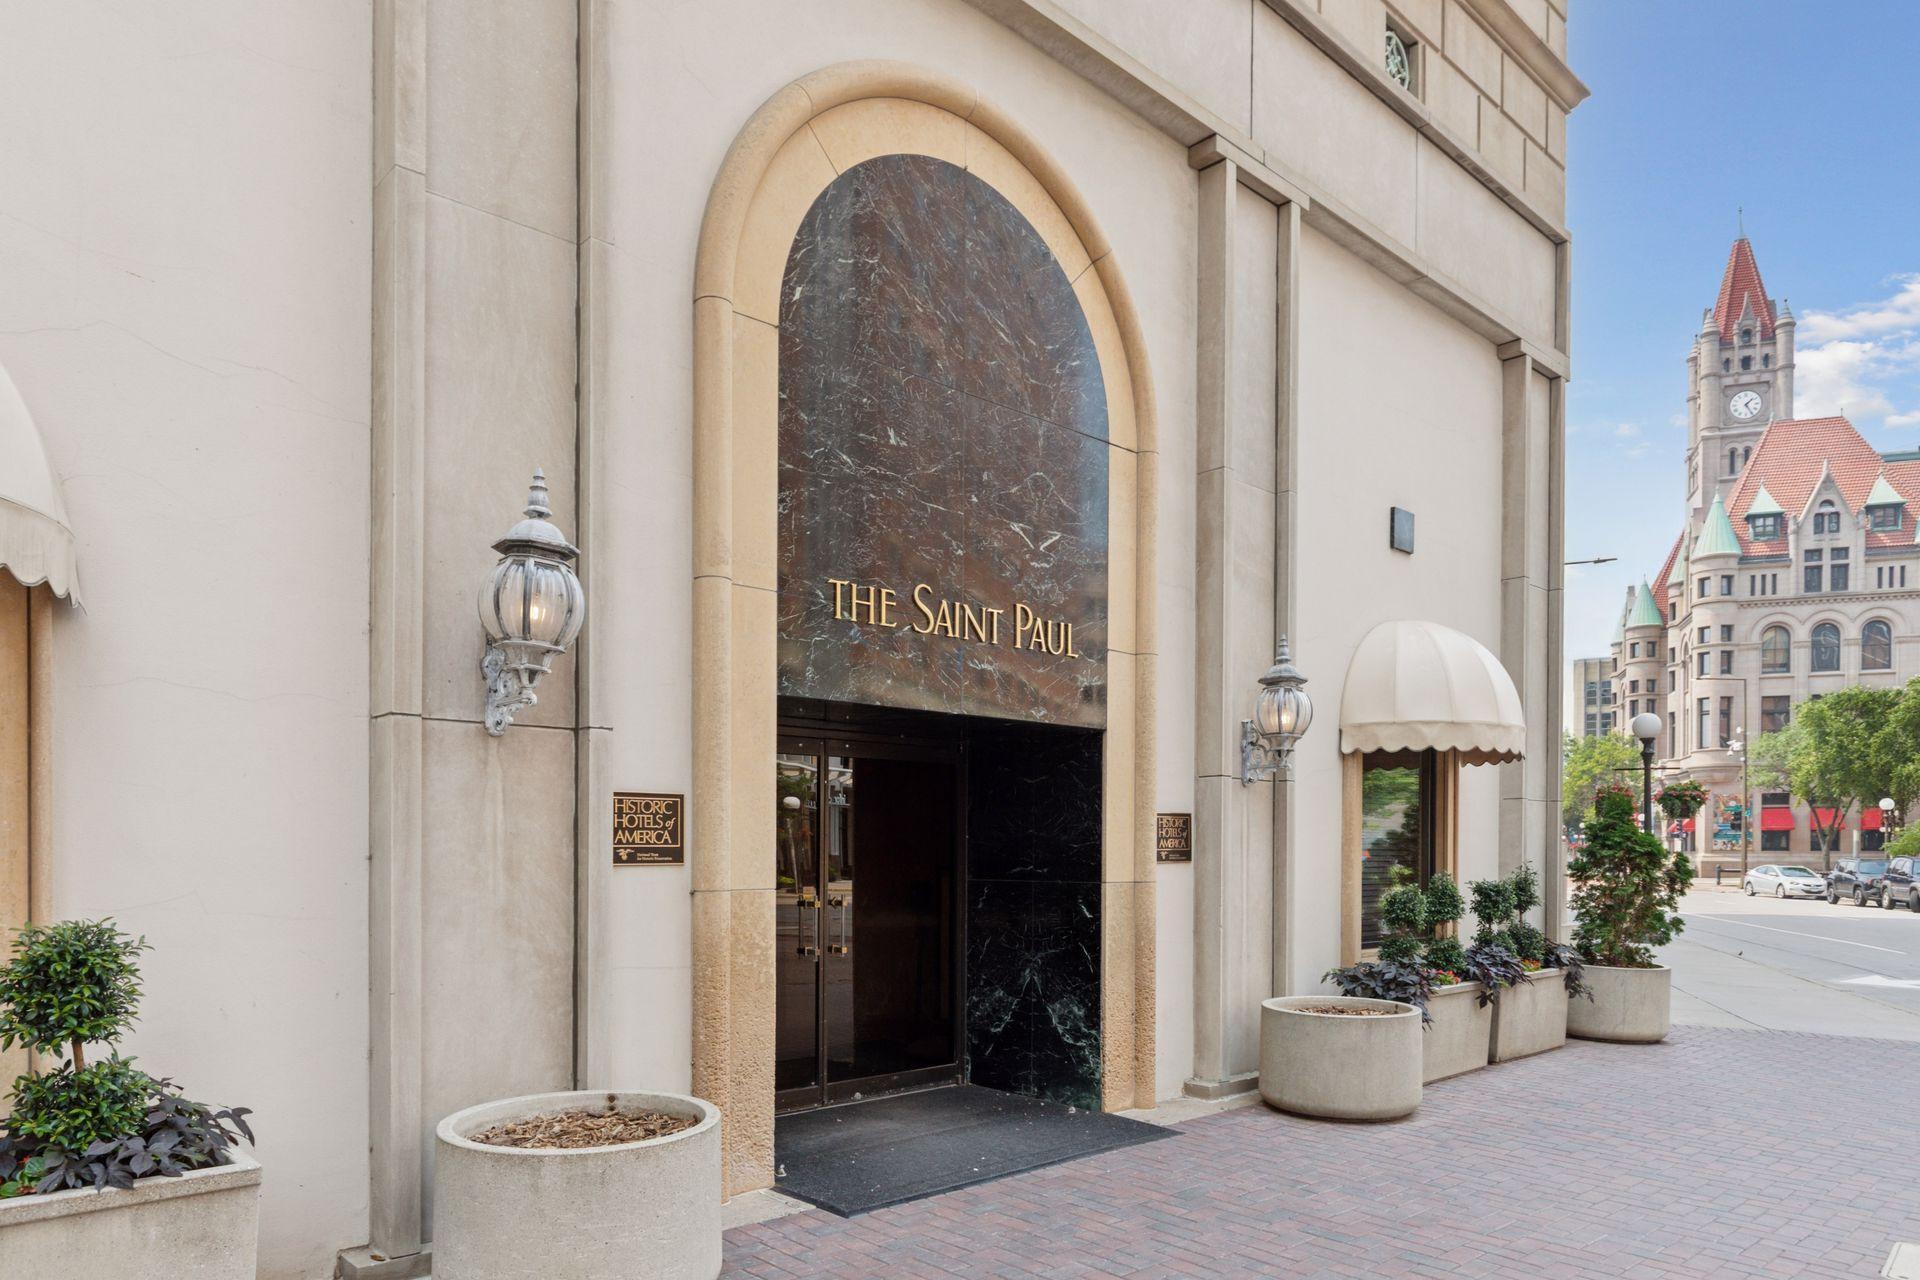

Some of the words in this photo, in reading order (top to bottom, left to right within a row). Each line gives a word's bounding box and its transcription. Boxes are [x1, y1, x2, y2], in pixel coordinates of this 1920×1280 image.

[828, 579, 898, 628] THE
[912, 583, 1004, 645] SAINT
[1013, 603, 1080, 659] PAUL
[614, 799, 673, 814] HISTORIC
[614, 814, 664, 828] HOTELS
[665, 817, 677, 830] of
[614, 830, 672, 844] AMERICA
